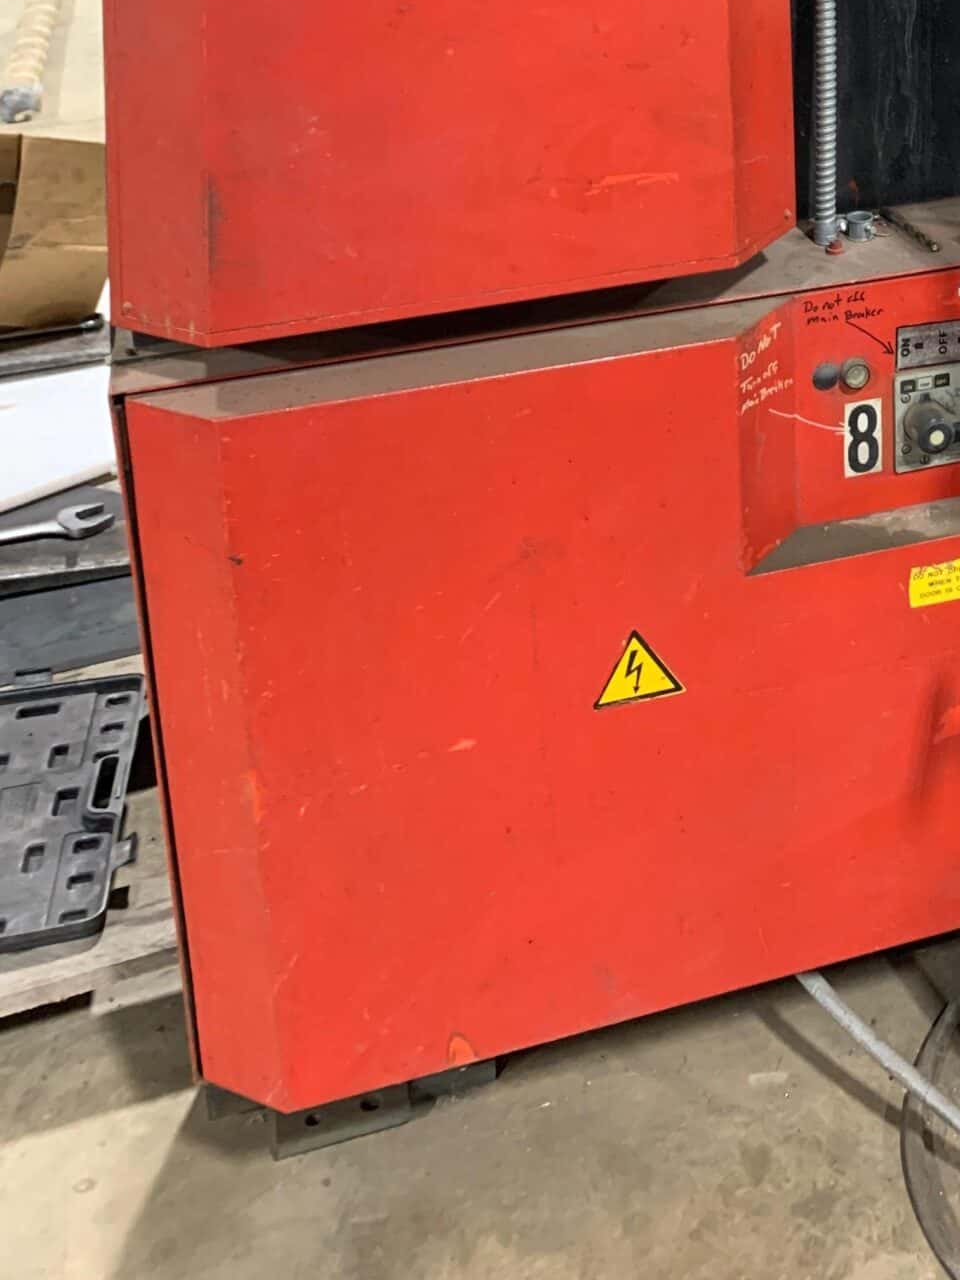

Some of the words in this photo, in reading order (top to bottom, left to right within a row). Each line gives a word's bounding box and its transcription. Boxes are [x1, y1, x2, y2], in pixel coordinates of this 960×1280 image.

[803, 300, 819, 313] Do
[822, 293, 843, 310] not
[901, 338, 911, 357] ON
[938, 329, 948, 354] OFF
[848, 404, 879, 473] 8
